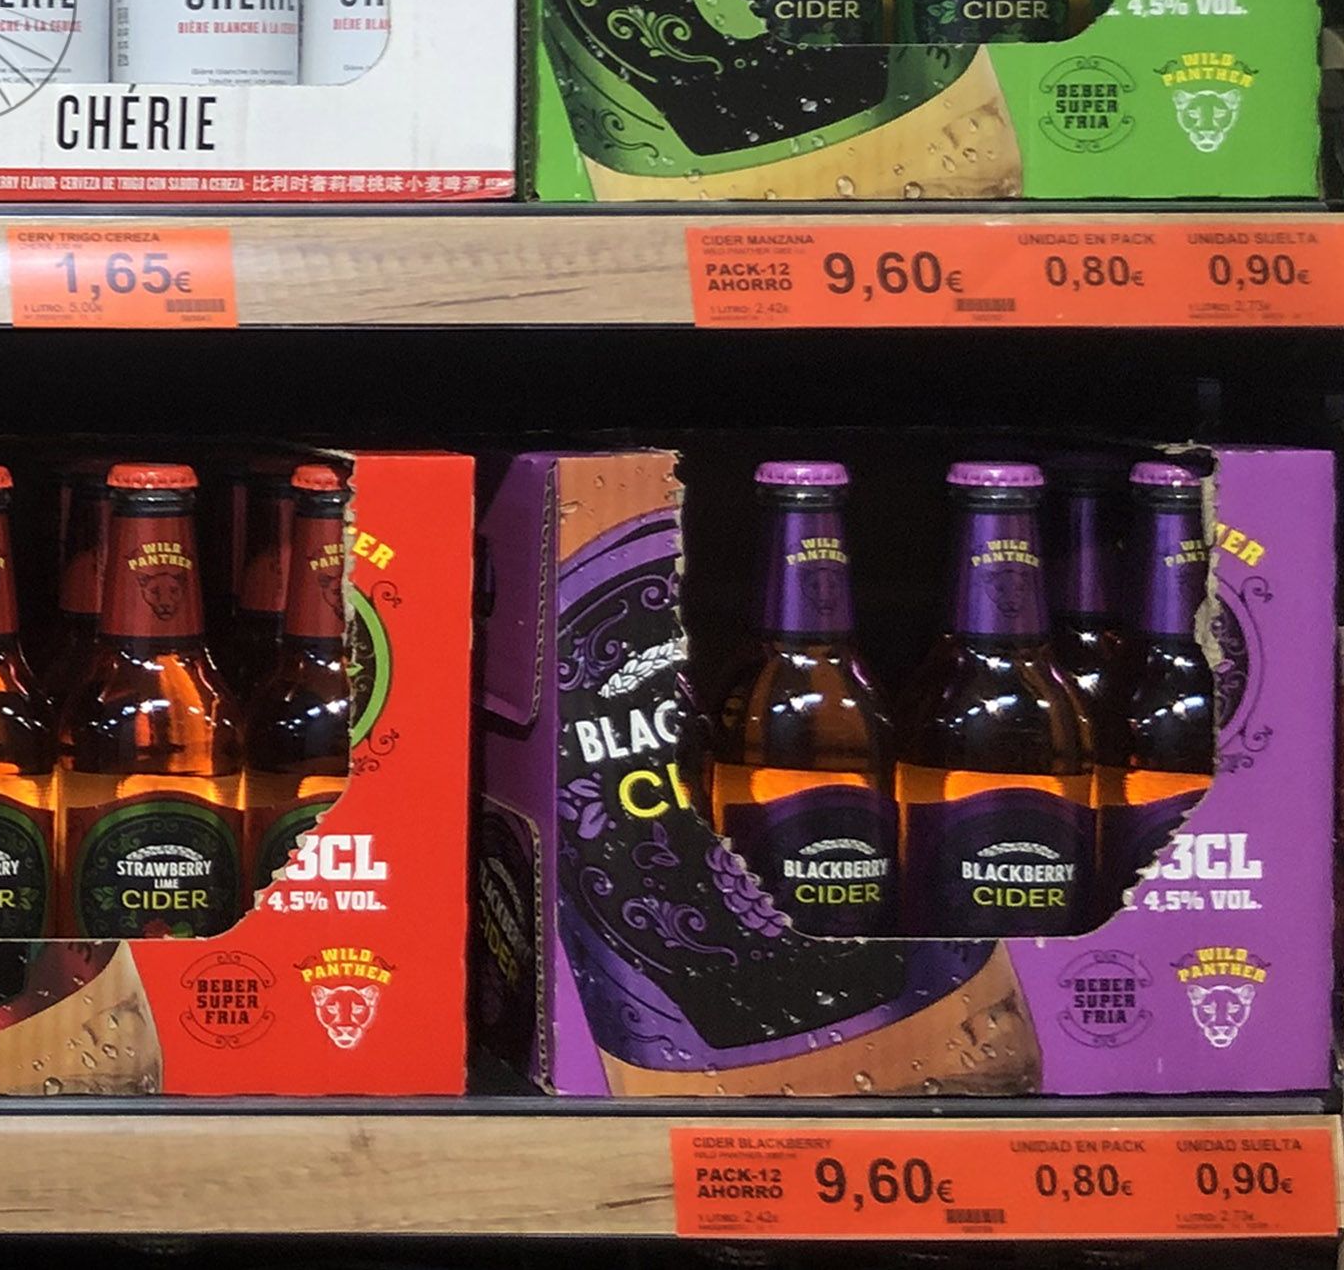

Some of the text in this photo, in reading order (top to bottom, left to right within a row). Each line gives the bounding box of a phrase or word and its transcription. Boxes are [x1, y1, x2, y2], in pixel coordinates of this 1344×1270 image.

[774, 0, 860, 19] CIDER
[1181, 52, 1234, 67] WILD
[1162, 67, 1255, 88] PANTHER
[56, 84, 217, 151] CHÉRIE
[18, 232, 160, 243] CERV TRIGO CEREZA
[702, 234, 815, 246] CIDER MANZANA
[1018, 233, 1155, 245] UNIDAD EN PACK
[1188, 233, 1318, 244] UNIDAD SUELTA
[55, 251, 192, 301] 1,65€
[706, 263, 790, 276] PACK-12
[823, 250, 963, 301] 9,60€
[1045, 255, 1145, 291] 0,80€
[1209, 254, 1311, 290] 0,90€
[708, 278, 792, 291] AHORRO
[116, 858, 211, 878] STRAWBERRY
[783, 858, 889, 879] BLACKBERRY
[962, 861, 1076, 883] BLACKBERRY
[122, 888, 210, 910] CIDER
[795, 884, 881, 905] CIDER
[973, 886, 1066, 908] CIDER
[1144, 889, 1262, 912] 4,5% VOL.
[1195, 948, 1248, 963] WILD
[1179, 961, 1266, 983] PANTHER
[197, 979, 258, 994] BEBER
[196, 995, 259, 1009] SUPER
[205, 1010, 250, 1025] FRIA
[693, 1137, 832, 1149] CIDER BLACKBERRY
[696, 1168, 782, 1182] PACK-12
[815, 1157, 955, 1212] 9,60€
[1035, 1163, 1133, 1202] 0,80€
[1196, 1162, 1294, 1201] 0,90€
[697, 1184, 783, 1199] AHORRO
